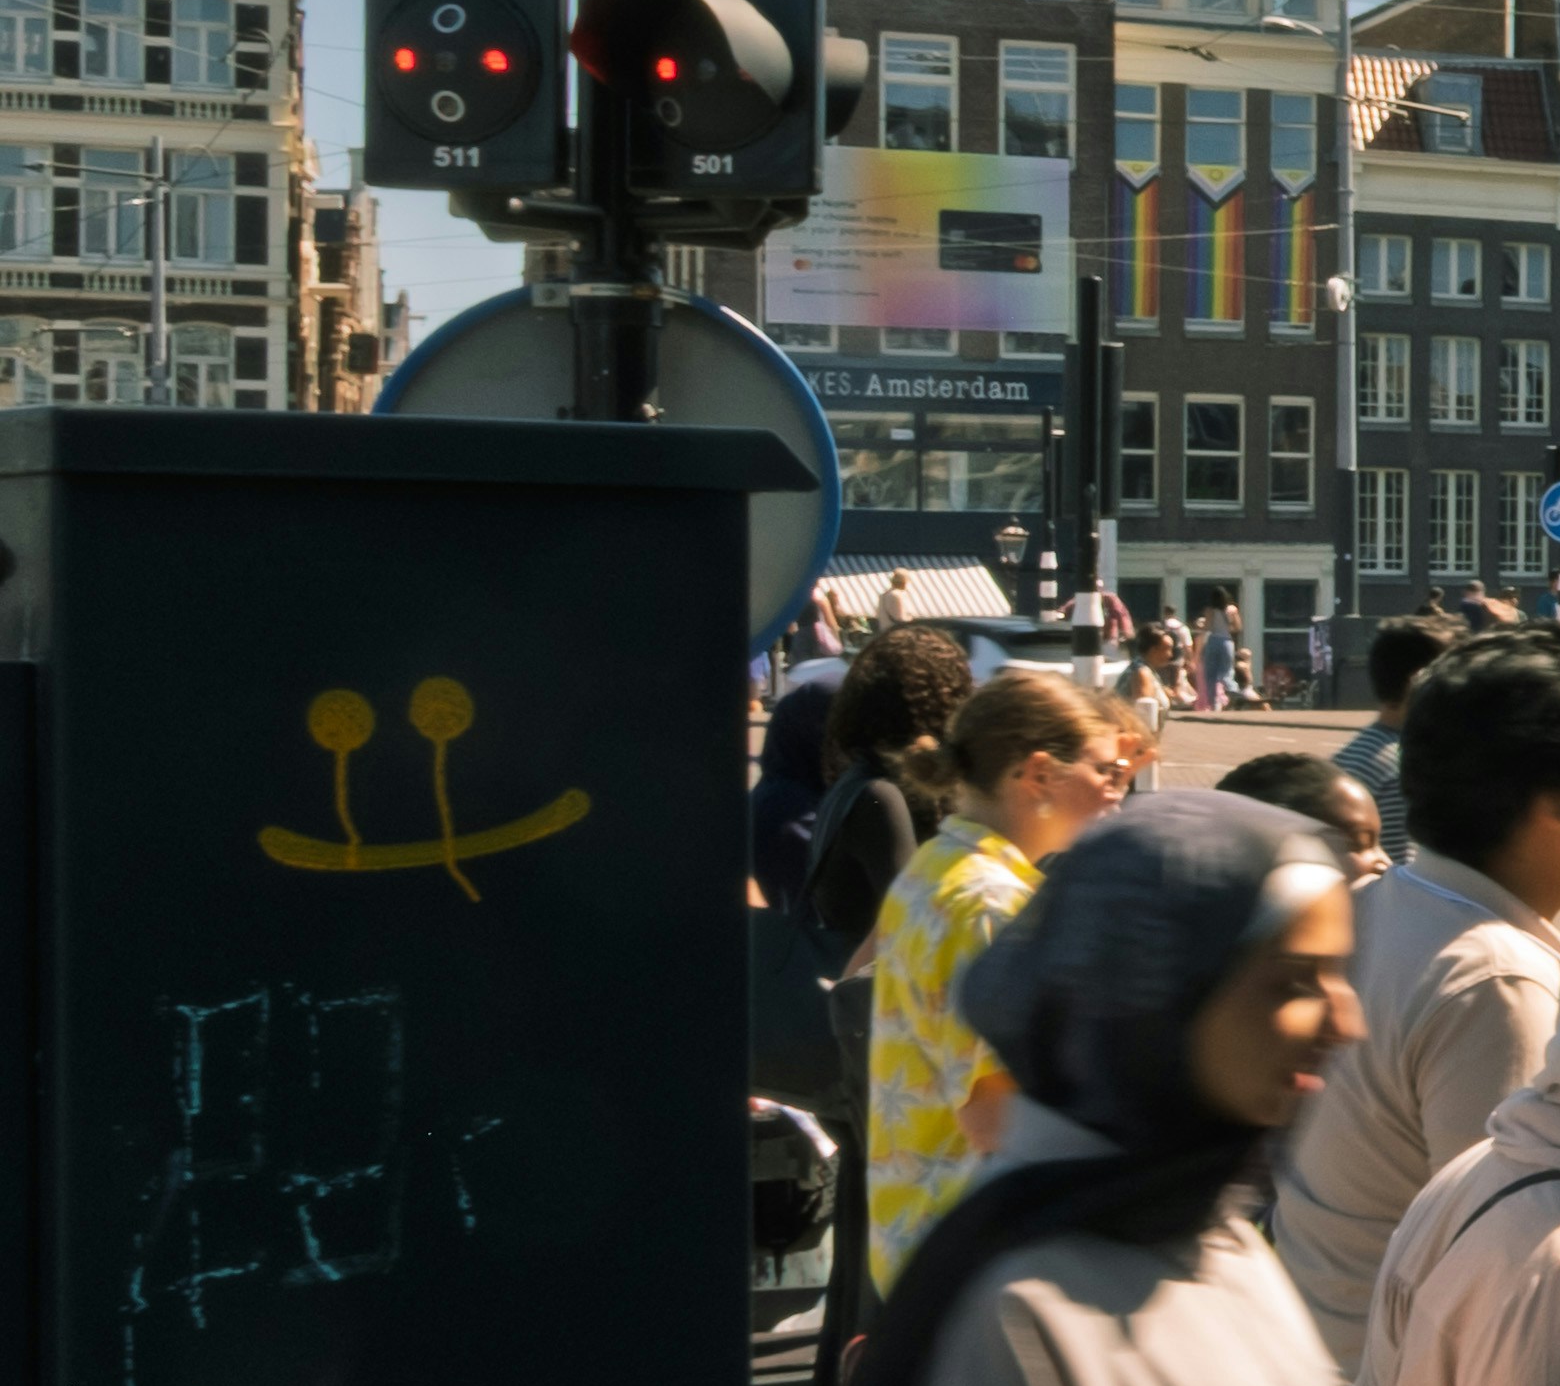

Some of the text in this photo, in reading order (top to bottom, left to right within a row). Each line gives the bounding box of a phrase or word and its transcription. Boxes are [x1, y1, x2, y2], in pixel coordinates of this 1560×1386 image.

[433, 146, 481, 168] 511
[692, 154, 734, 175] 501
[865, 373, 1030, 401] Amsterdam
